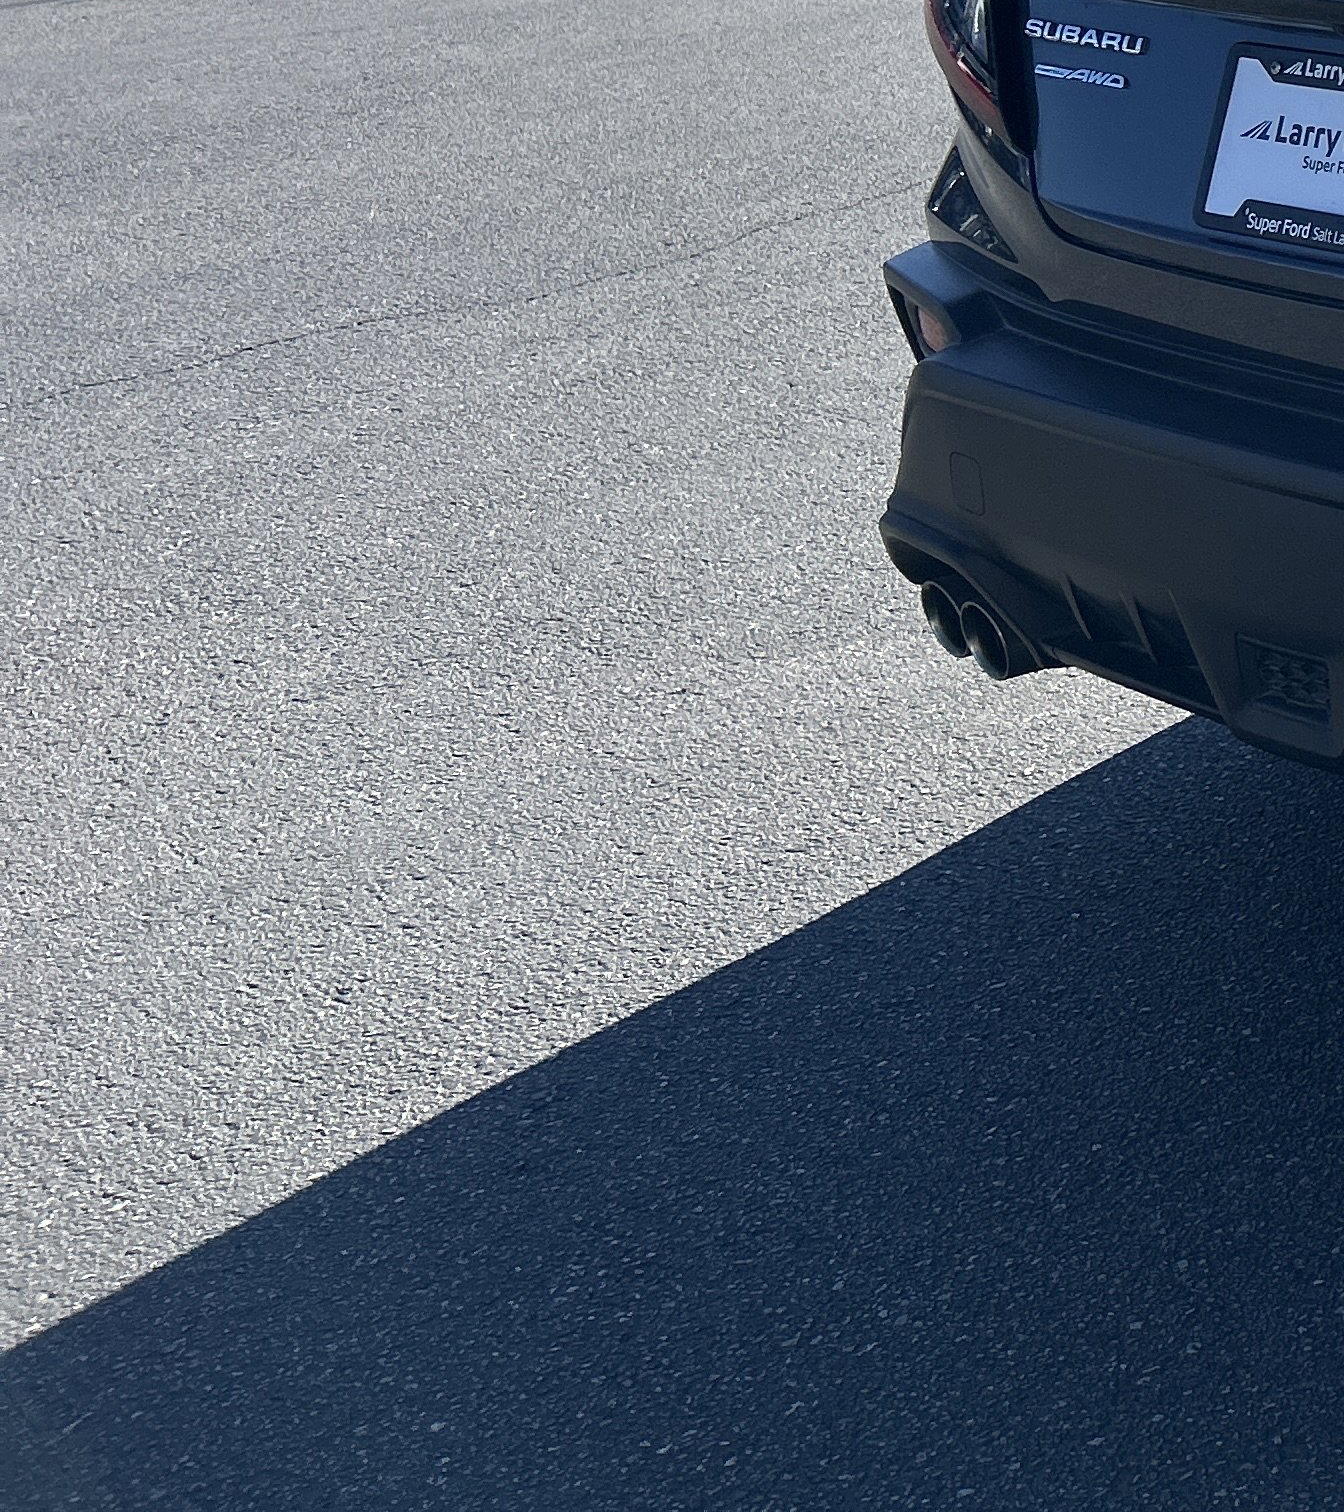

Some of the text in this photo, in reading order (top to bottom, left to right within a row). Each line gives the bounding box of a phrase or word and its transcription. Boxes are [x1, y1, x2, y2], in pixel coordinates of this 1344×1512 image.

[1024, 18, 1144, 55] SUBARU
[1065, 68, 1125, 89] AWD
[1274, 115, 1342, 157] Larry
[1302, 156, 1336, 175] Super
[1247, 213, 1282, 235] Super
[1282, 219, 1310, 239] Ford
[1312, 226, 1332, 243] Salt
